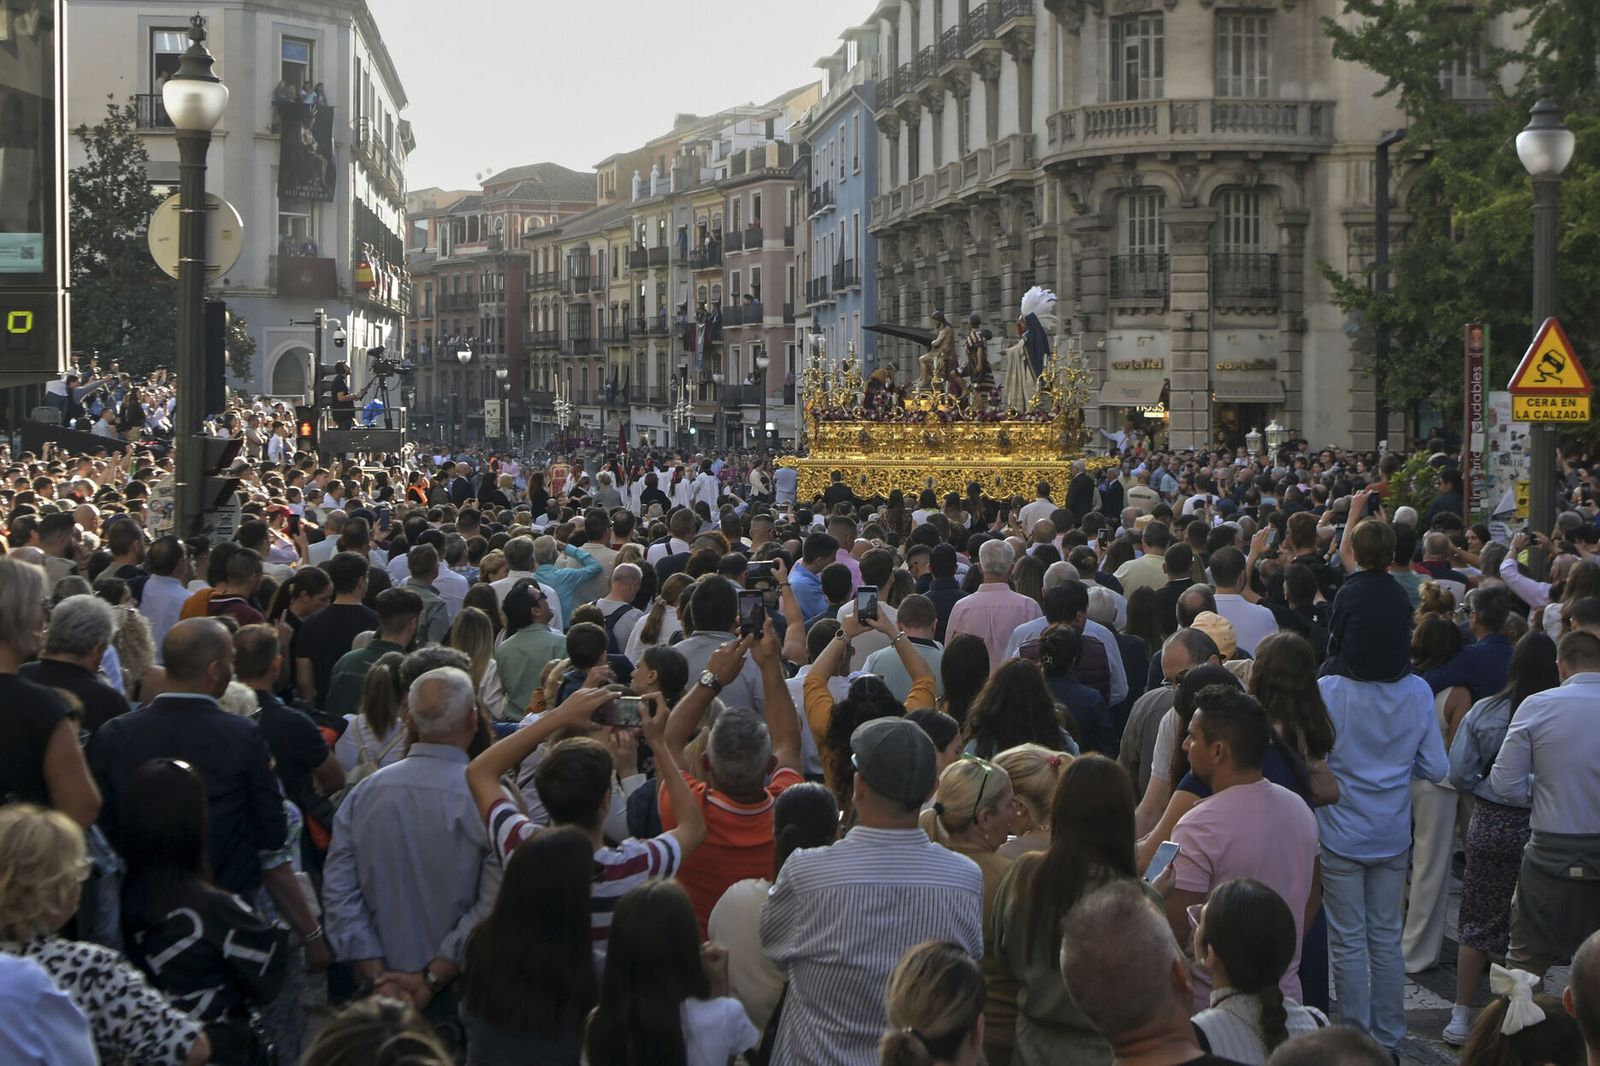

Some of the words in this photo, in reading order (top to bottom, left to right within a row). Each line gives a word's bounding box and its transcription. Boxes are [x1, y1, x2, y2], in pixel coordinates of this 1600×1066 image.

[1526, 398, 1557, 407] CERA
[1561, 398, 1576, 407] EN
[1515, 410, 1530, 419] LA
[1533, 410, 1587, 419] CALZADA
